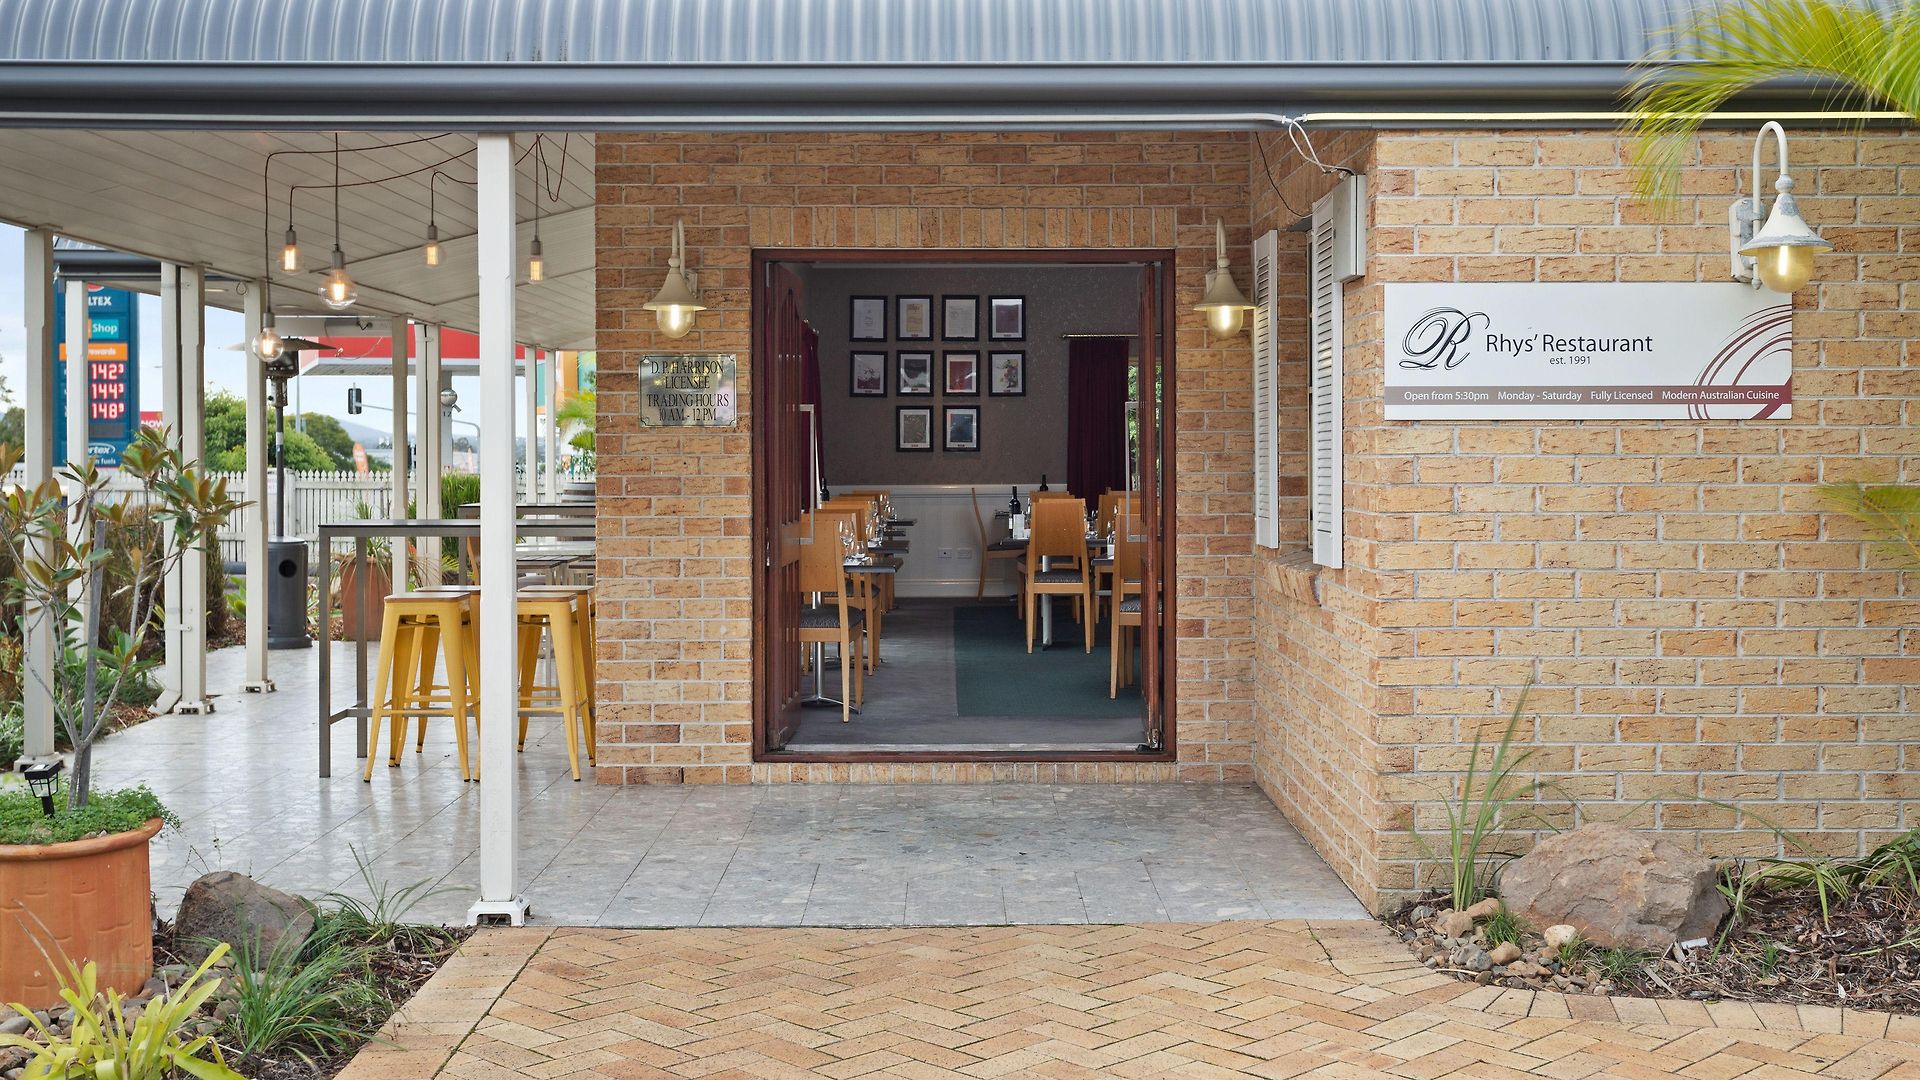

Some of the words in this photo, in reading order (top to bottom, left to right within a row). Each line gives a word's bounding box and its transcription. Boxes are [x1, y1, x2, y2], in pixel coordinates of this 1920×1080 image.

[88, 296, 112, 306] LTEX
[92, 323, 118, 335] Shop
[1486, 334, 1538, 357] Rhys'
[1543, 334, 1653, 352] Restaurant
[1549, 356, 1566, 365] est.
[1569, 356, 1591, 365] 1991
[671, 361, 724, 374] HARRISON
[665, 376, 711, 389] LICENSEE
[647, 394, 693, 407] TRADING
[695, 394, 729, 407] HOURS
[1404, 391, 1429, 402] Open
[1431, 391, 1454, 400] from
[1455, 391, 1489, 402] 5:30pm
[1498, 391, 1535, 402] Monday
[1542, 391, 1582, 402] Saturday
[1590, 391, 1612, 402] Fully
[1614, 391, 1653, 400] Licensed
[1662, 391, 1698, 400] Modern
[1700, 391, 1745, 400] Australian
[1747, 390, 1780, 400] Cuisine
